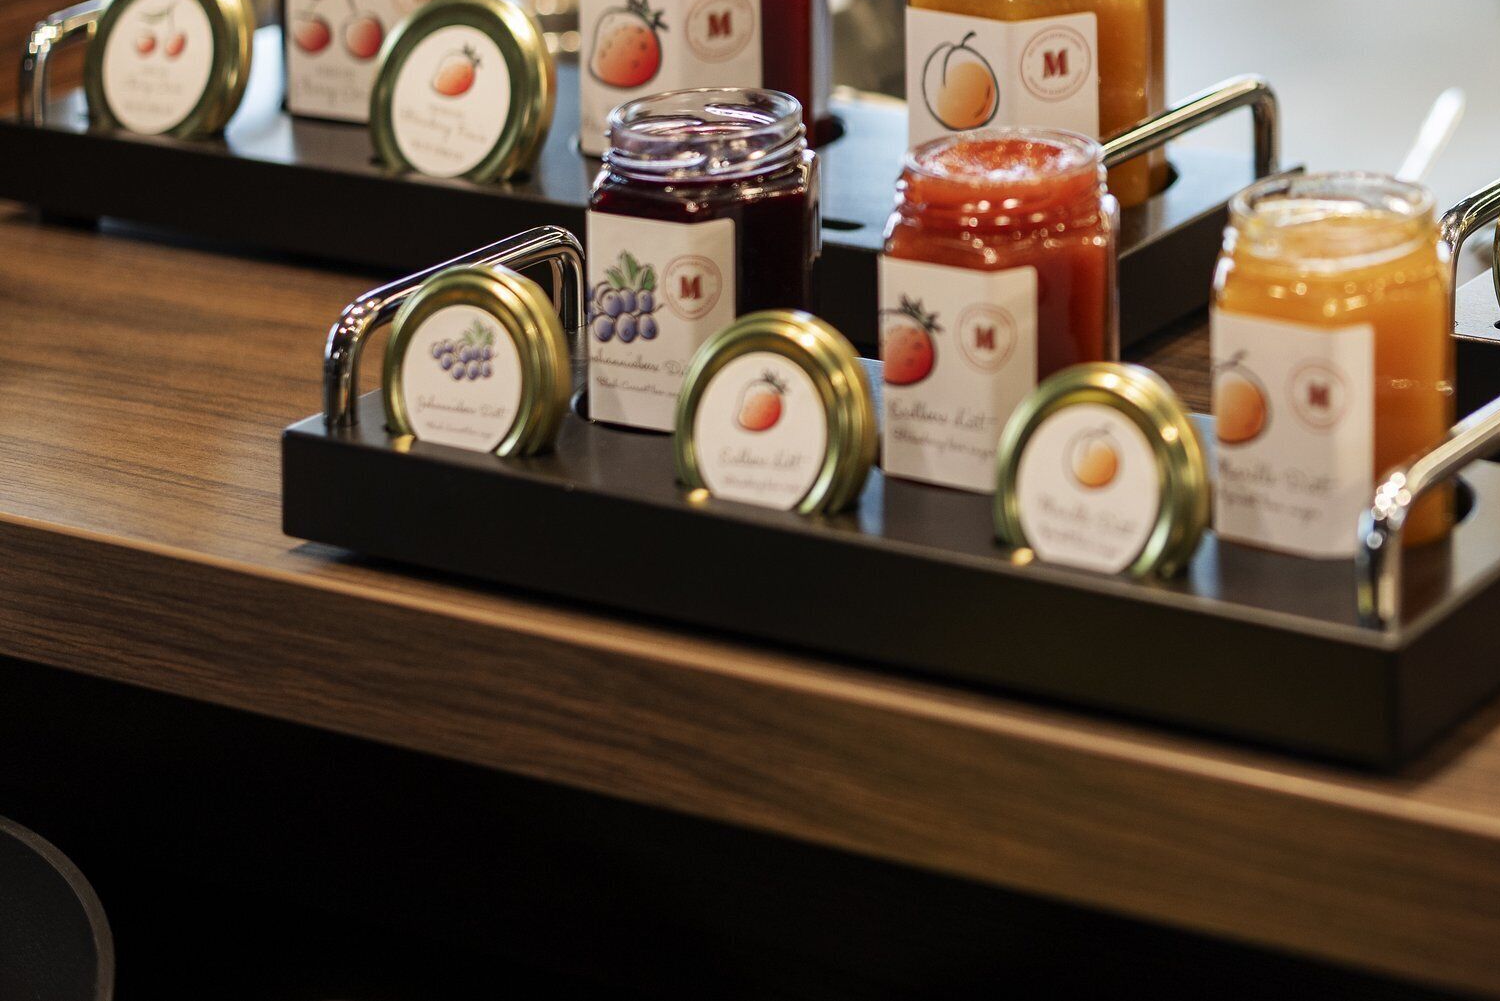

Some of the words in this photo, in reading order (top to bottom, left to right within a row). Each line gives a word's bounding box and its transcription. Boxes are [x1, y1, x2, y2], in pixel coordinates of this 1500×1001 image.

[708, 10, 733, 38] M
[1043, 48, 1069, 80] M
[679, 275, 702, 300] M
[974, 325, 998, 350] M
